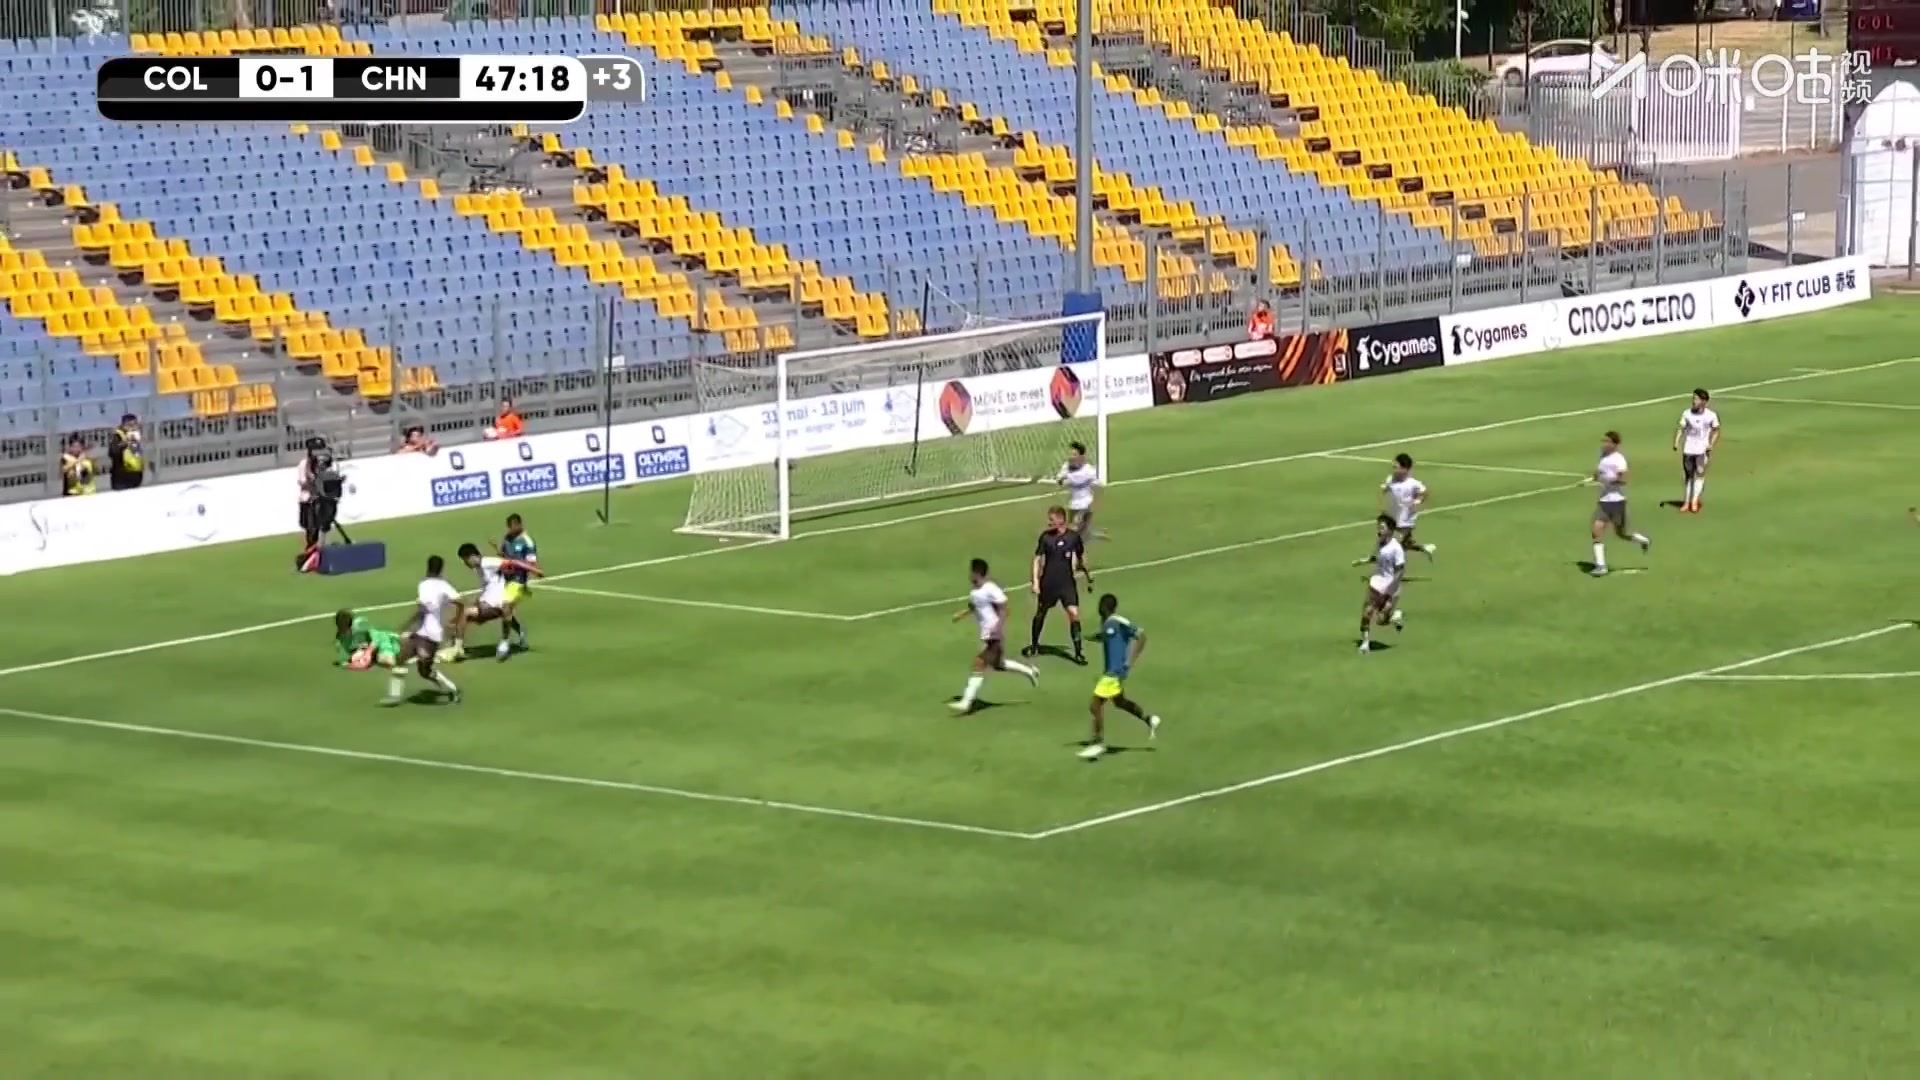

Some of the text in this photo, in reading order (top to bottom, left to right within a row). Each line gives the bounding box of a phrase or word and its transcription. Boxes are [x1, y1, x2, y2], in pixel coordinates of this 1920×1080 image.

[1858, 15, 1894, 30] COL
[1759, 287, 1769, 305] Y
[1772, 282, 1793, 304] FIT
[1796, 275, 1832, 299] CLUB
[1568, 292, 1696, 336] CROSS ZERO
[1463, 323, 1528, 351] Cygames
[1370, 335, 1437, 366] Cygames
[1113, 375, 1124, 387] to
[1126, 372, 1149, 386] meet
[973, 386, 1045, 407] MOVE to meet
[761, 409, 779, 426] 31
[820, 399, 839, 417] 13
[841, 398, 866, 417] juin
[639, 448, 686, 467] OLYMPIC
[504, 465, 555, 484] OLYMPIC
[640, 462, 687, 477] LOCATION
[434, 474, 488, 495] OLYMPIC
[505, 481, 556, 495] LOCATION
[436, 489, 489, 505] LOCATION
